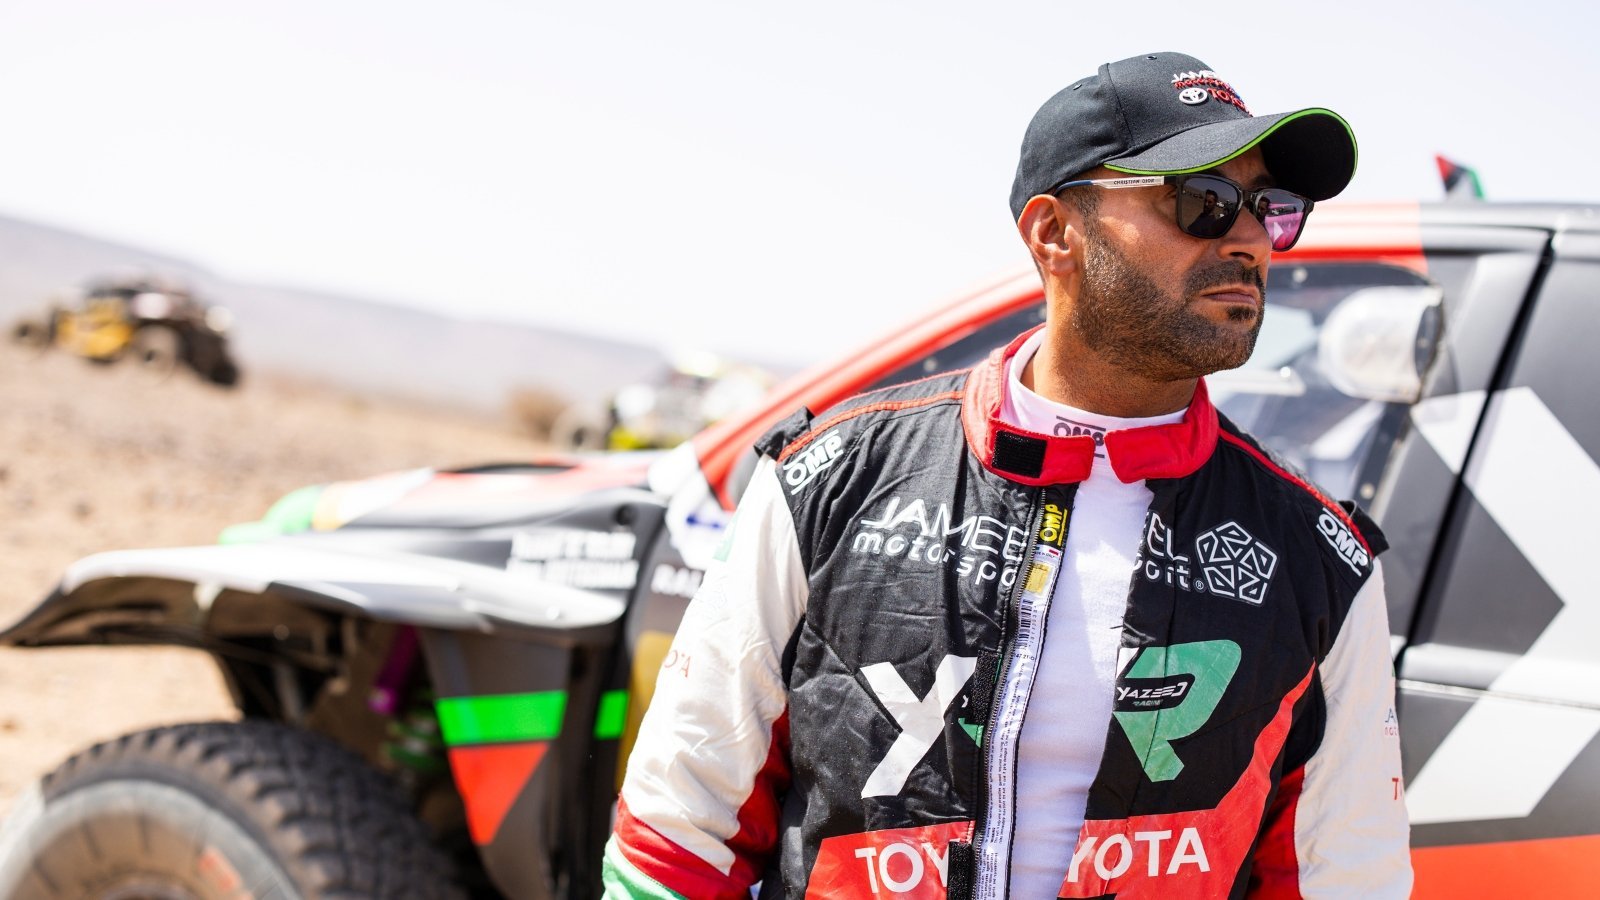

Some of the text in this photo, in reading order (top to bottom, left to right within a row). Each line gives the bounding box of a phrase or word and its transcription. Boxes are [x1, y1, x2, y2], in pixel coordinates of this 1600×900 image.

[786, 434, 844, 486] OMP
[1039, 503, 1063, 542] OMP
[1318, 513, 1368, 567] OMP
[1116, 681, 1188, 701] YAZEED
